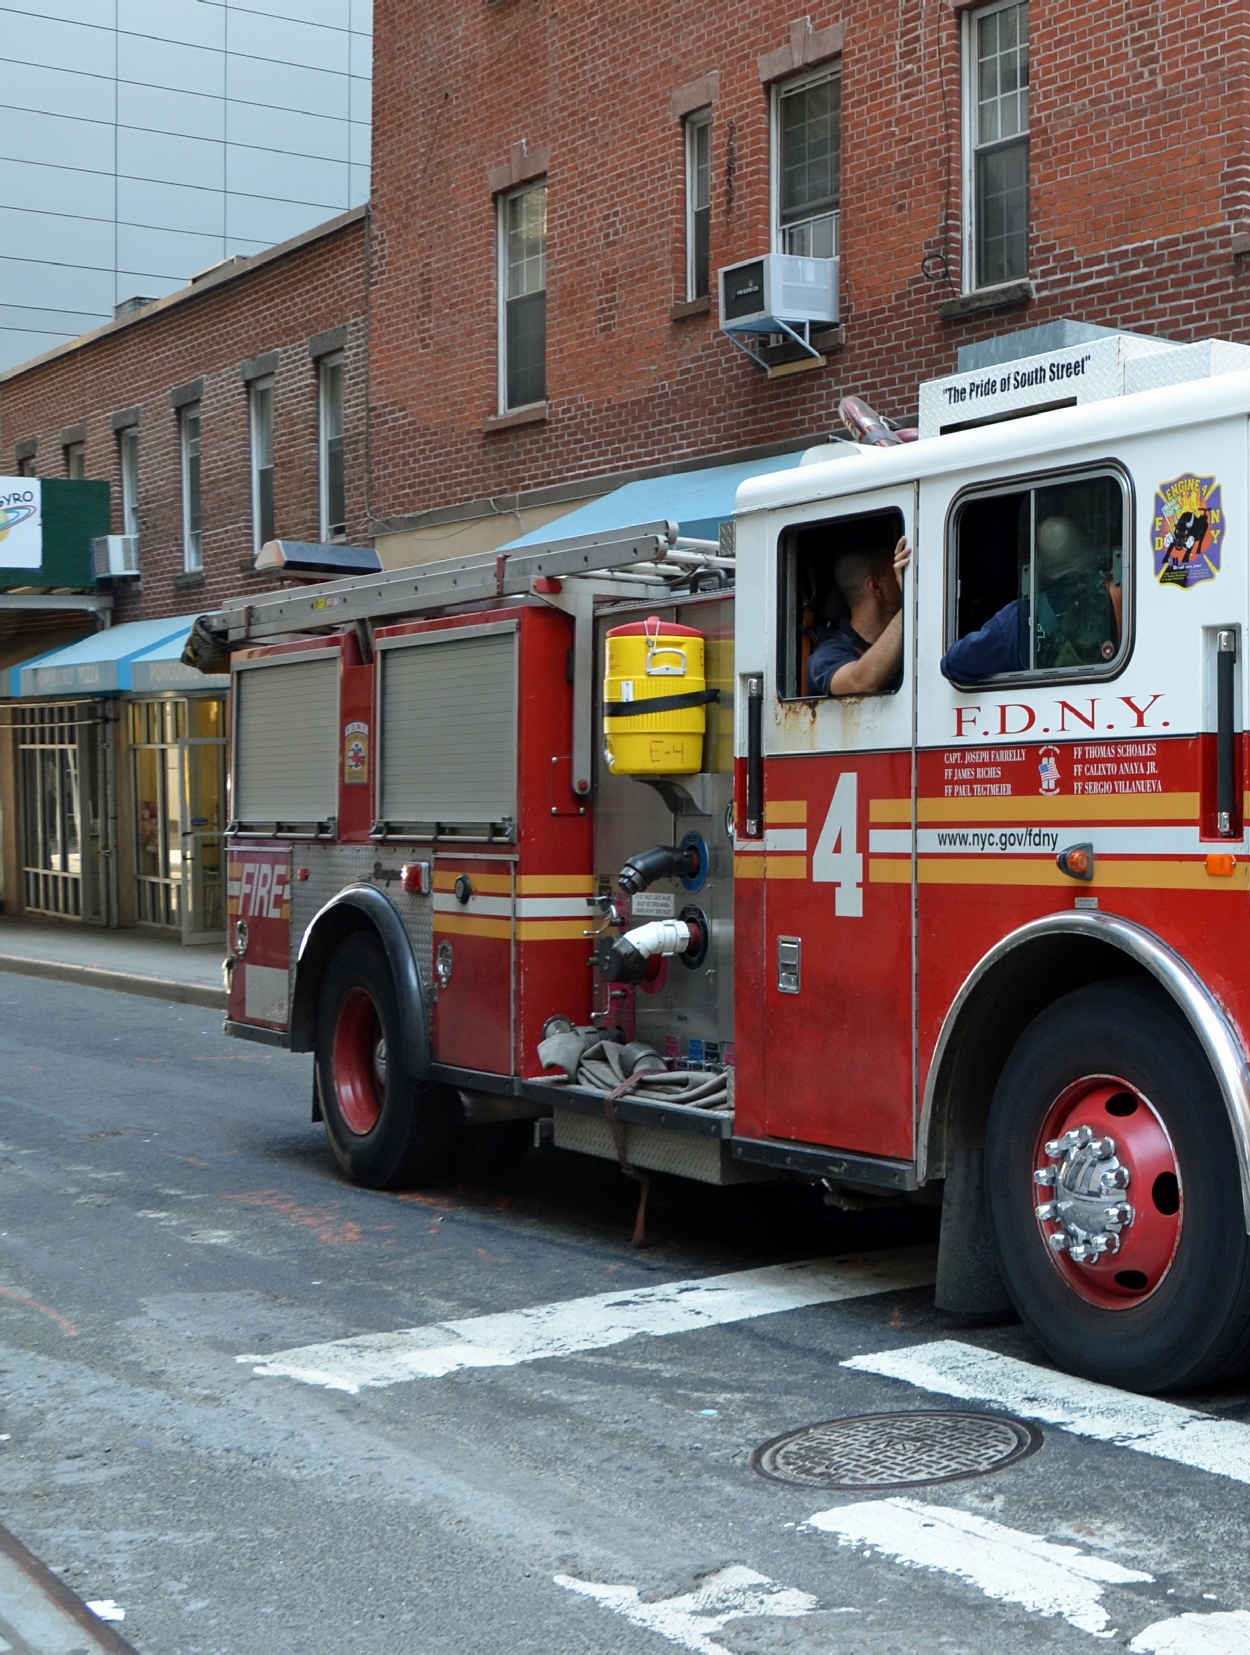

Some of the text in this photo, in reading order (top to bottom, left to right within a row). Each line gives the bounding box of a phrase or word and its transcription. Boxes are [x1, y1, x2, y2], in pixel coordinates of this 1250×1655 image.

[942, 355, 1091, 404] "The Pride of South Street"
[1165, 478, 1208, 500] ENGINE 4
[951, 694, 1170, 738] F.D.N.Y.
[650, 740, 684, 764] E-4
[944, 752, 963, 764] CAPT.
[965, 750, 990, 764] JOSEPH
[991, 749, 1026, 762] FARRELLY
[1073, 746, 1083, 759] FF
[1084, 745, 1116, 759] THOMAS
[1117, 743, 1157, 757] SCHOALES
[944, 767, 1002, 780] FF JAMES RICHES
[1073, 762, 1158, 776] FF CALIXTO ANAYA JR.
[944, 784, 953, 797] FF
[954, 784, 972, 796] PAUL
[1073, 782, 1083, 794] FF
[1084, 781, 1112, 794] SERGIO
[1114, 779, 1163, 793] VILLANUEVA
[812, 771, 864, 918] 4
[937, 827, 1059, 851] www.nyc.gov/fdny
[237, 863, 287, 919] FIRE
